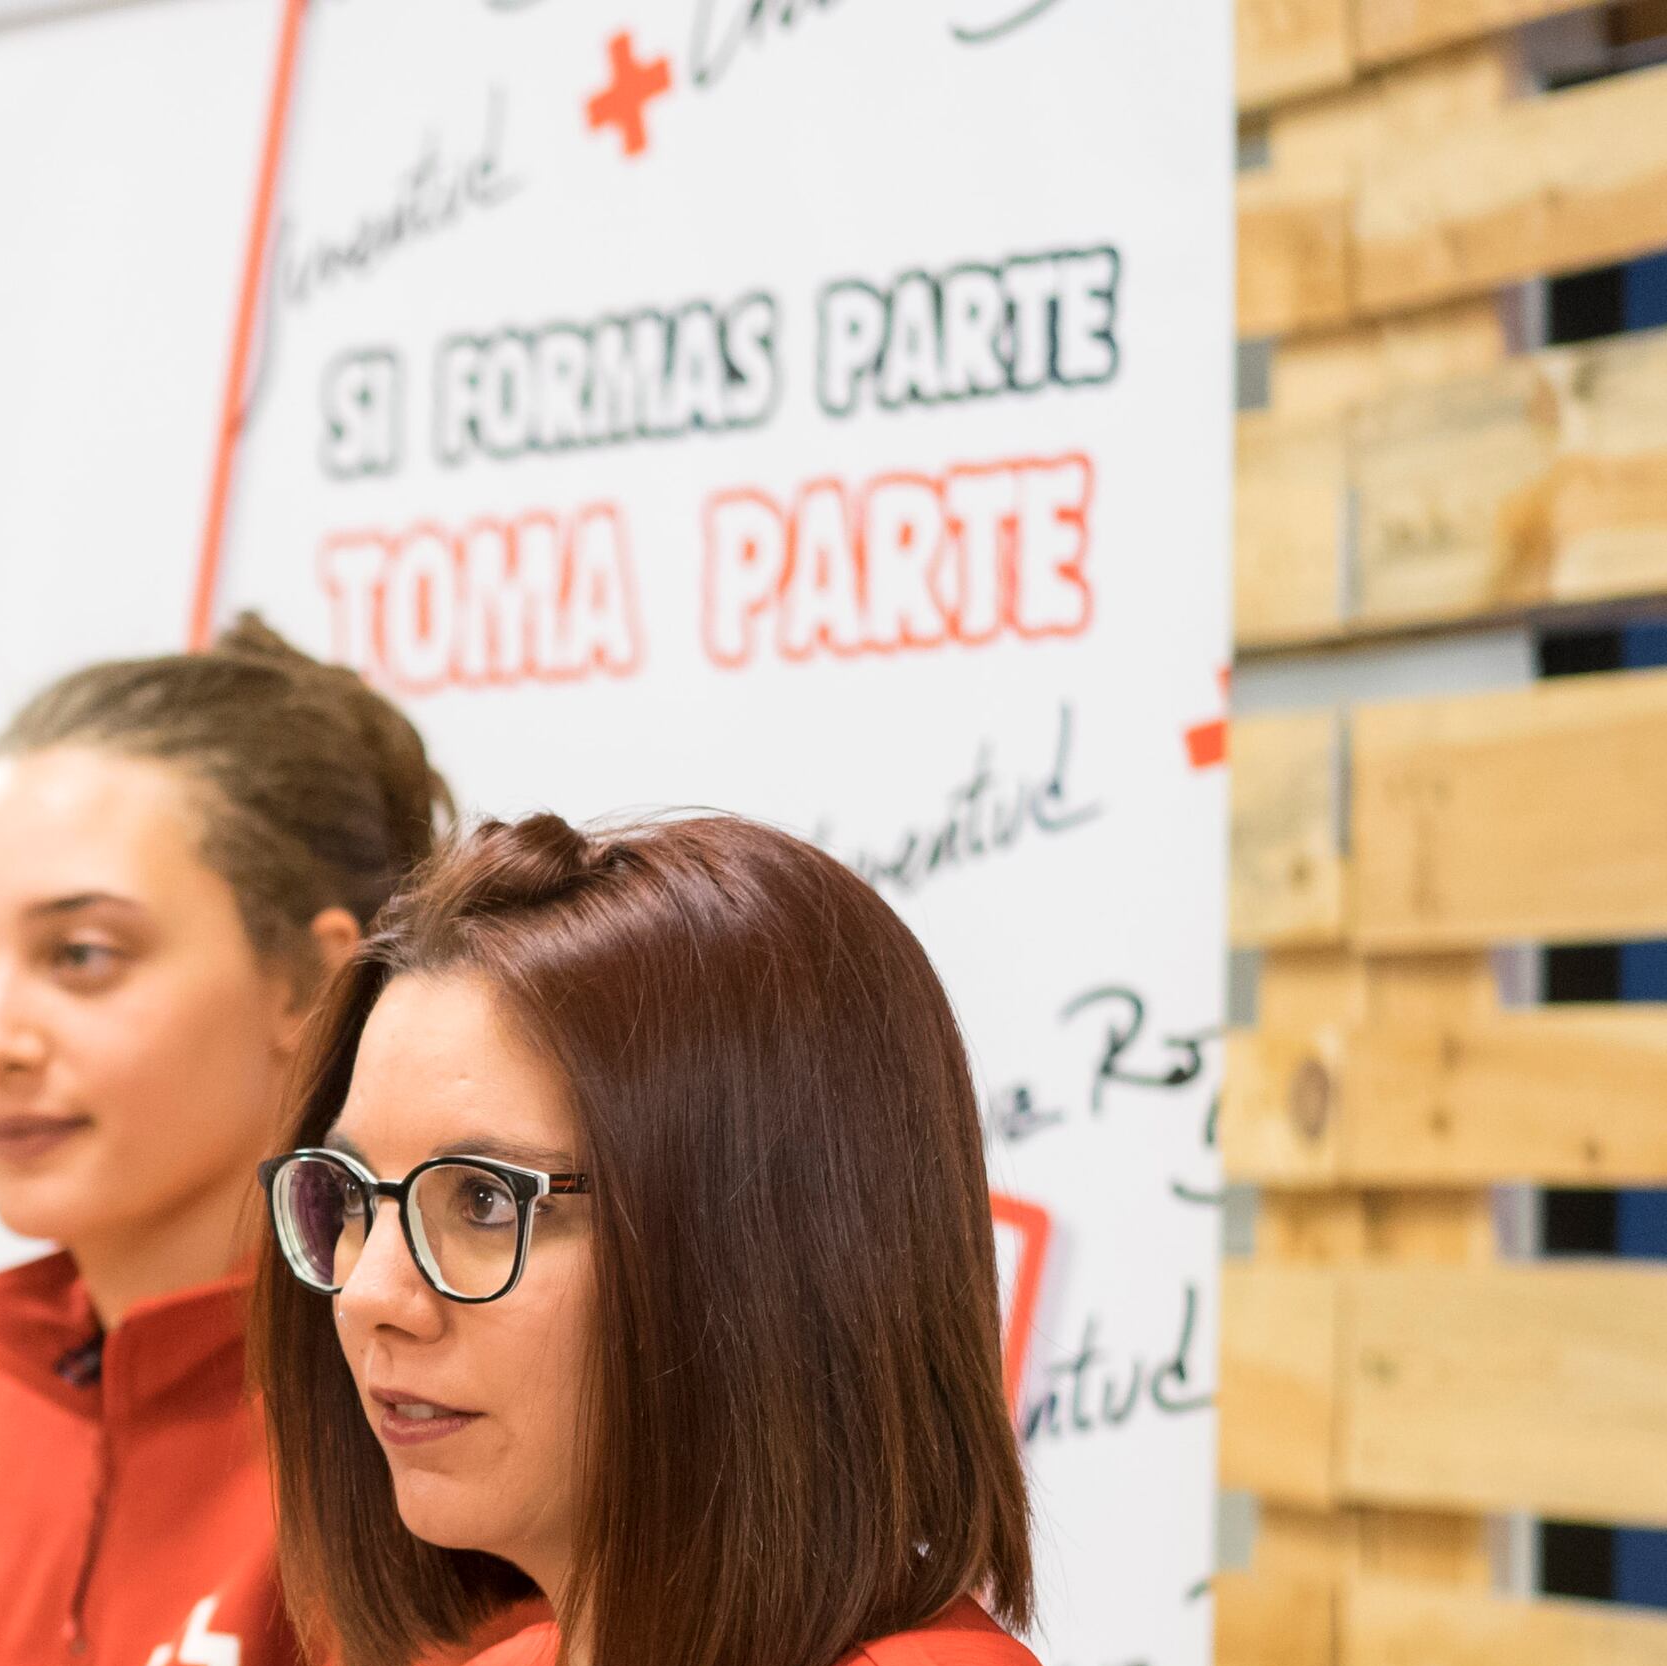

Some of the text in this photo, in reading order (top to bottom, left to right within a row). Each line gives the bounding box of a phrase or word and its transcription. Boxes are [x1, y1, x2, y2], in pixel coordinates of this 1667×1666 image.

[320, 244, 1124, 481] SI FORMAS PARTE
[320, 452, 1097, 695] TOMA PARTE
